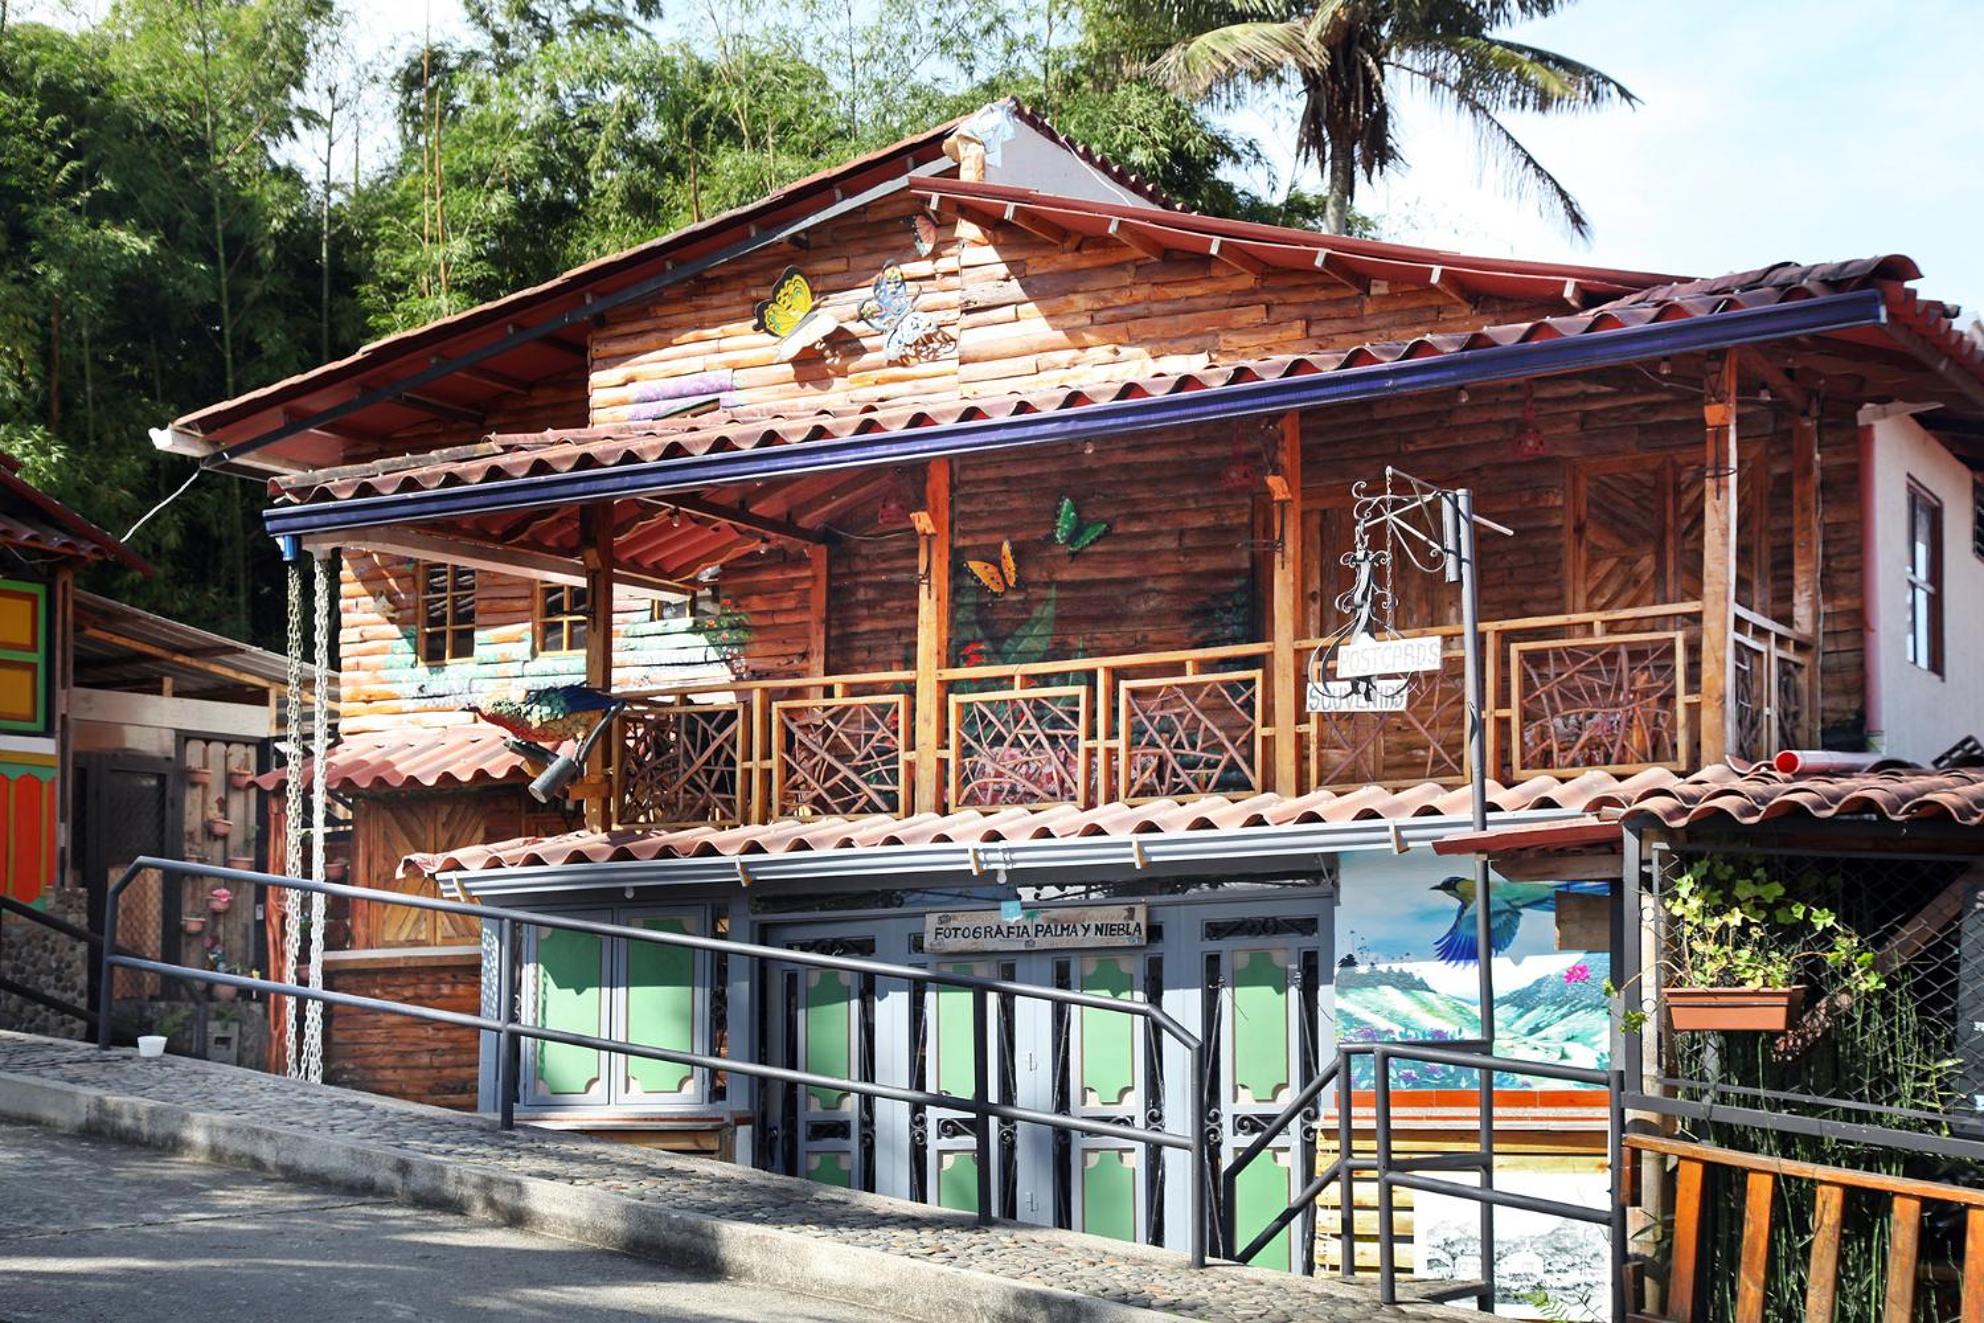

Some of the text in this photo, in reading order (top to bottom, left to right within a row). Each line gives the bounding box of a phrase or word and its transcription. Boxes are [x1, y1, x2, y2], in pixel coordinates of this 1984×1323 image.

[1338, 641, 1440, 677] POSTCARDS
[934, 922, 1142, 940] FOTOGRAFIA PALMA Y NIEBLA
